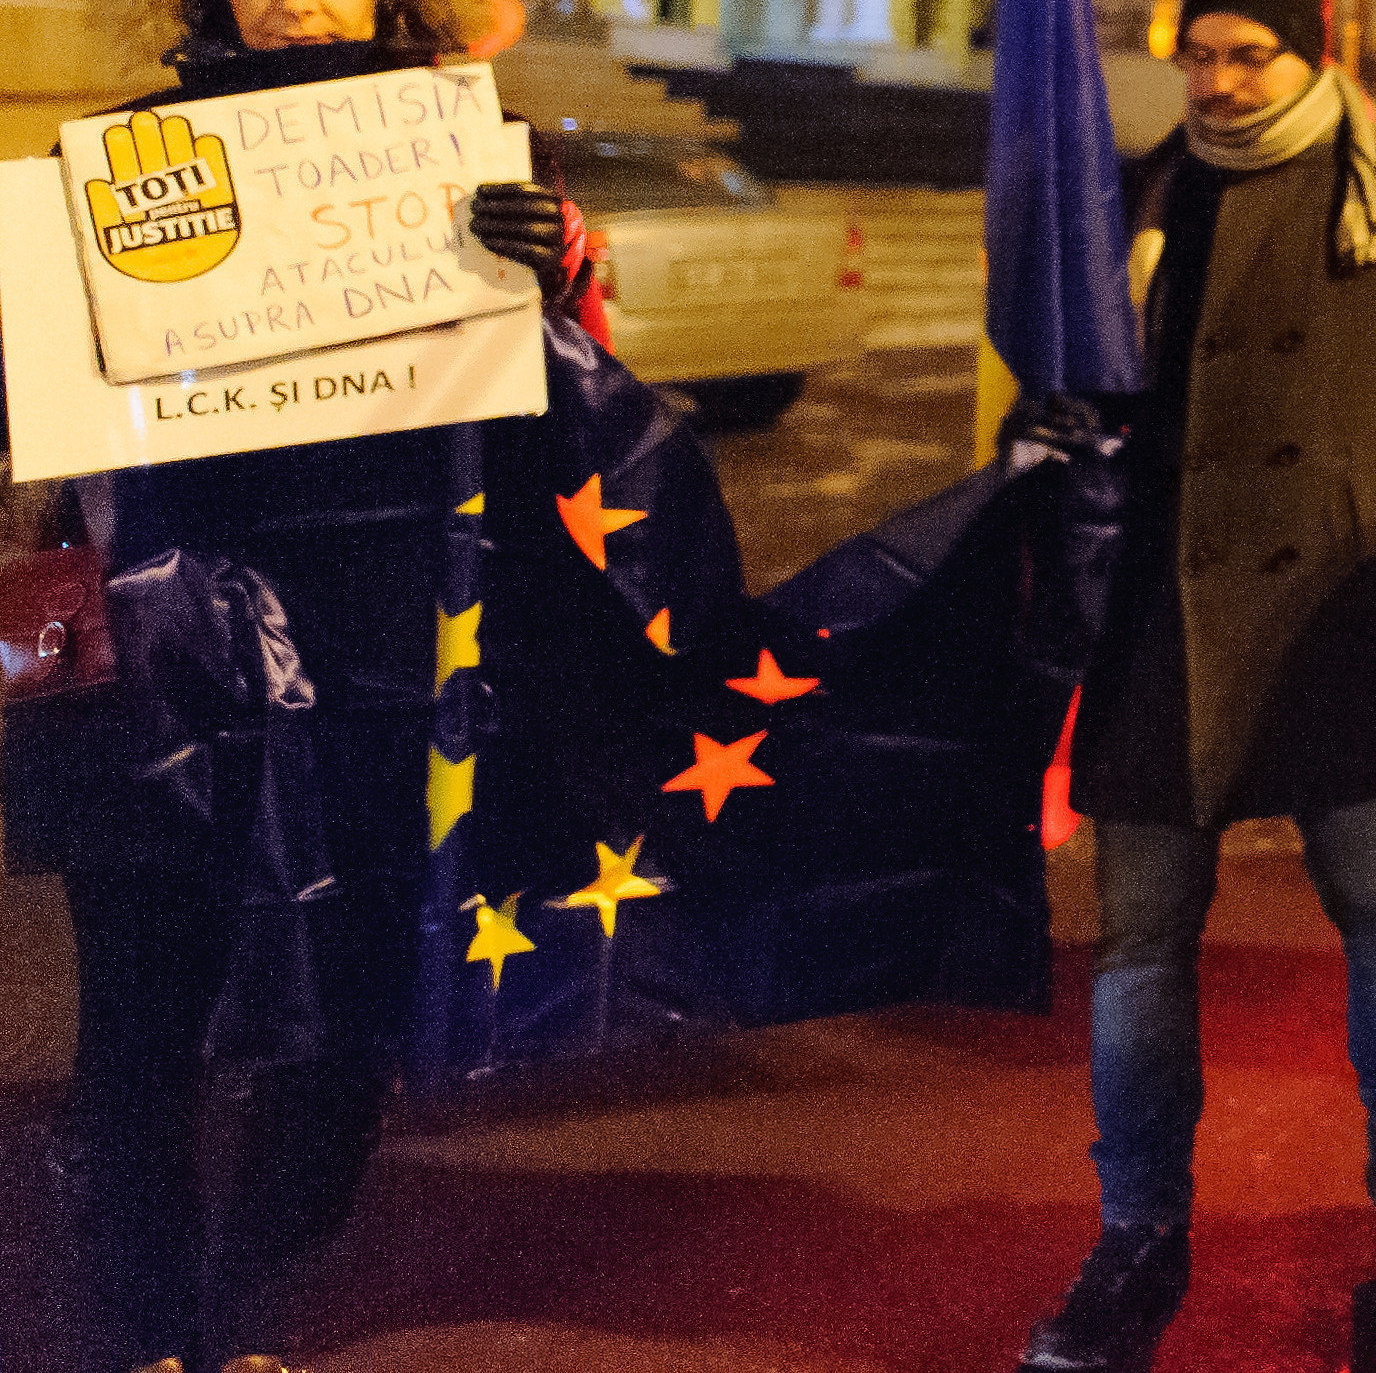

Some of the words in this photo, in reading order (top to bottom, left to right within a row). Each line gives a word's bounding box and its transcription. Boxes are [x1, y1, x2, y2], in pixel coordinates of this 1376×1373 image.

[237, 83, 481, 151] DEMISIA
[310, 181, 468, 250] STOP
[164, 300, 317, 357] ASUPRA
[343, 267, 453, 320] DNA
[155, 386, 257, 422] L.C.K.
[314, 368, 394, 401] DNA
